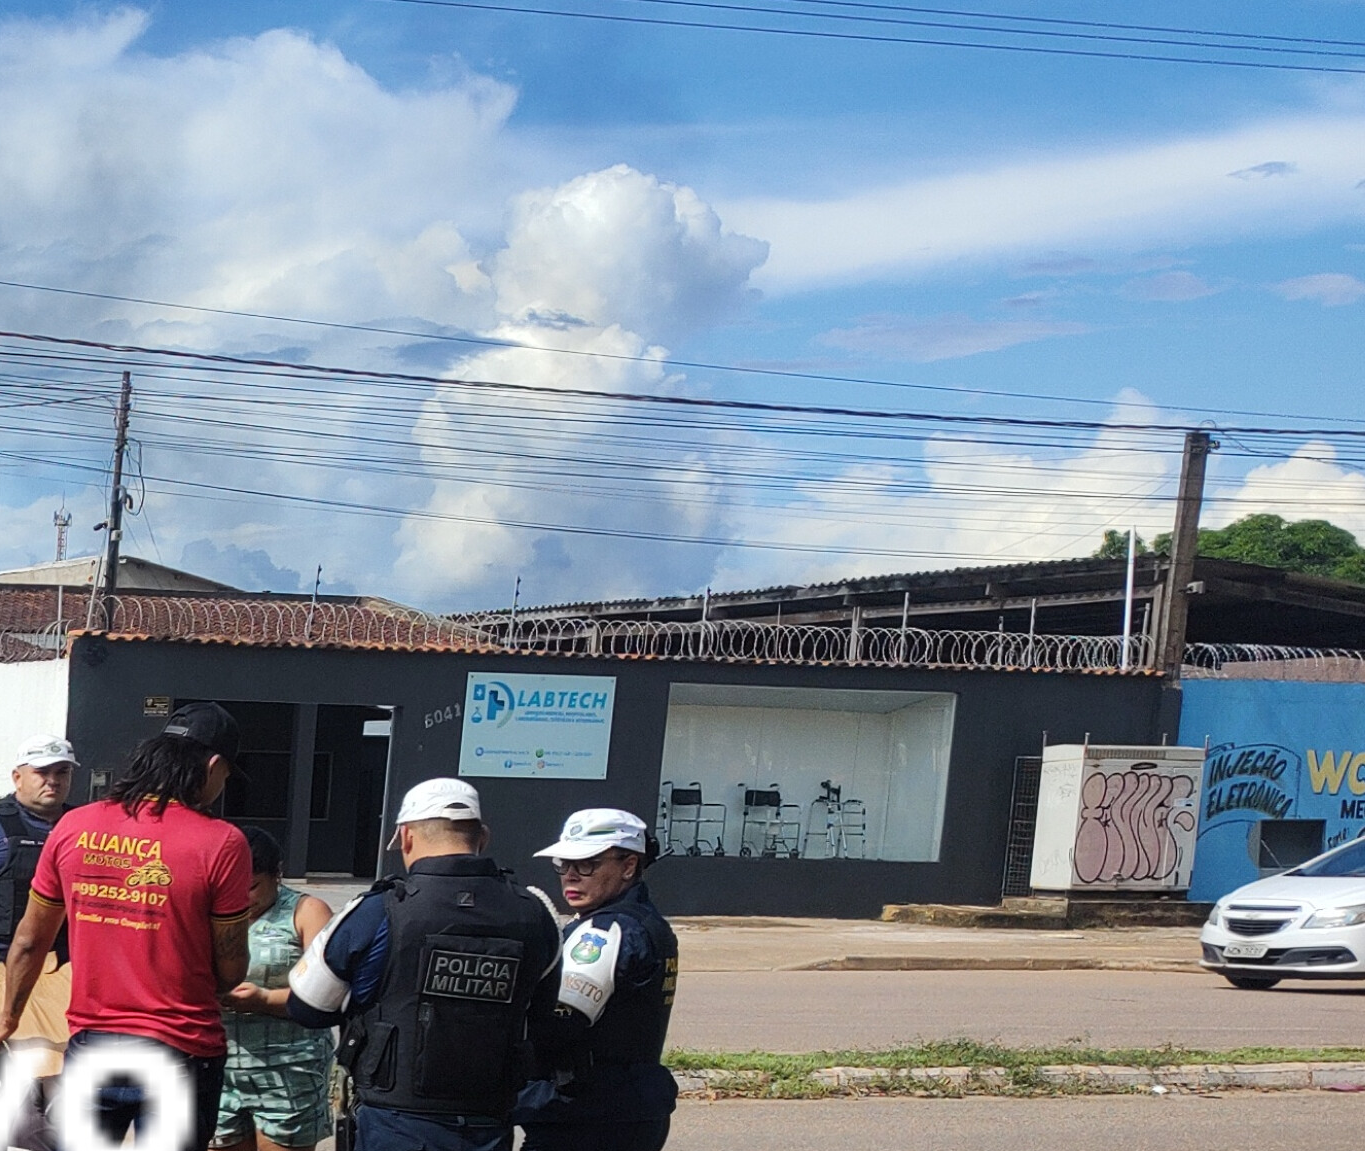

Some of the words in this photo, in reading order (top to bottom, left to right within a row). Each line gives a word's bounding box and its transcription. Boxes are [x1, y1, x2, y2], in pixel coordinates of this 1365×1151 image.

[517, 690, 608, 710] LABTECH
[1208, 750, 1288, 790] INJEÇÃO
[1205, 781, 1294, 820] ELETRÔNICA
[75, 831, 162, 862] ALIANÇA
[82, 853, 133, 870] MOTOS
[79, 883, 168, 907] 99252-9107
[434, 956, 512, 980] POLÍCIA
[430, 974, 509, 998] MILITAR
